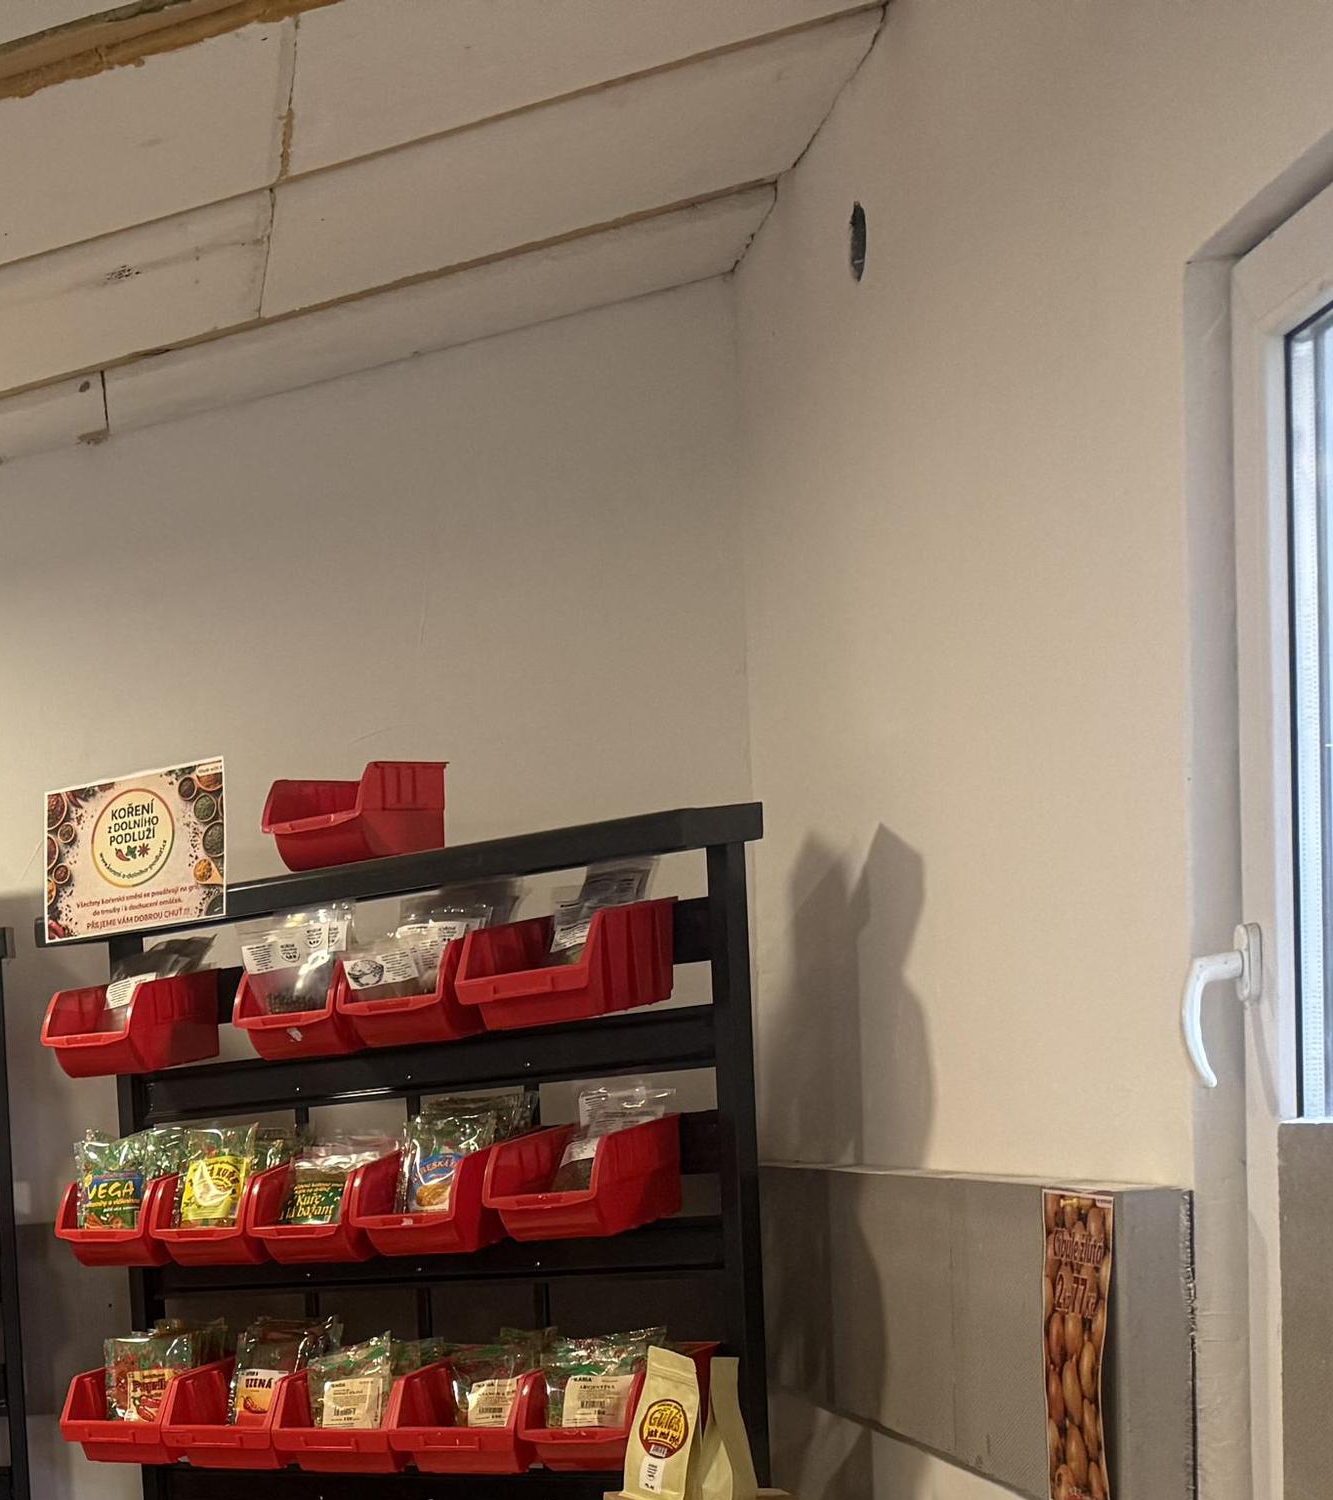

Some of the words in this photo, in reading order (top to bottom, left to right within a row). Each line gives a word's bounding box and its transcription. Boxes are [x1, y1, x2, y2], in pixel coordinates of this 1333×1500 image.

[111, 799, 155, 821] KOŘENÍ
[113, 816, 159, 832] DOLNÍHO
[109, 827, 155, 846] PODLUŽÍ
[118, 914, 133, 926] VÁM
[134, 911, 163, 923] DOBROU
[87, 1179, 135, 1200] VEGA
